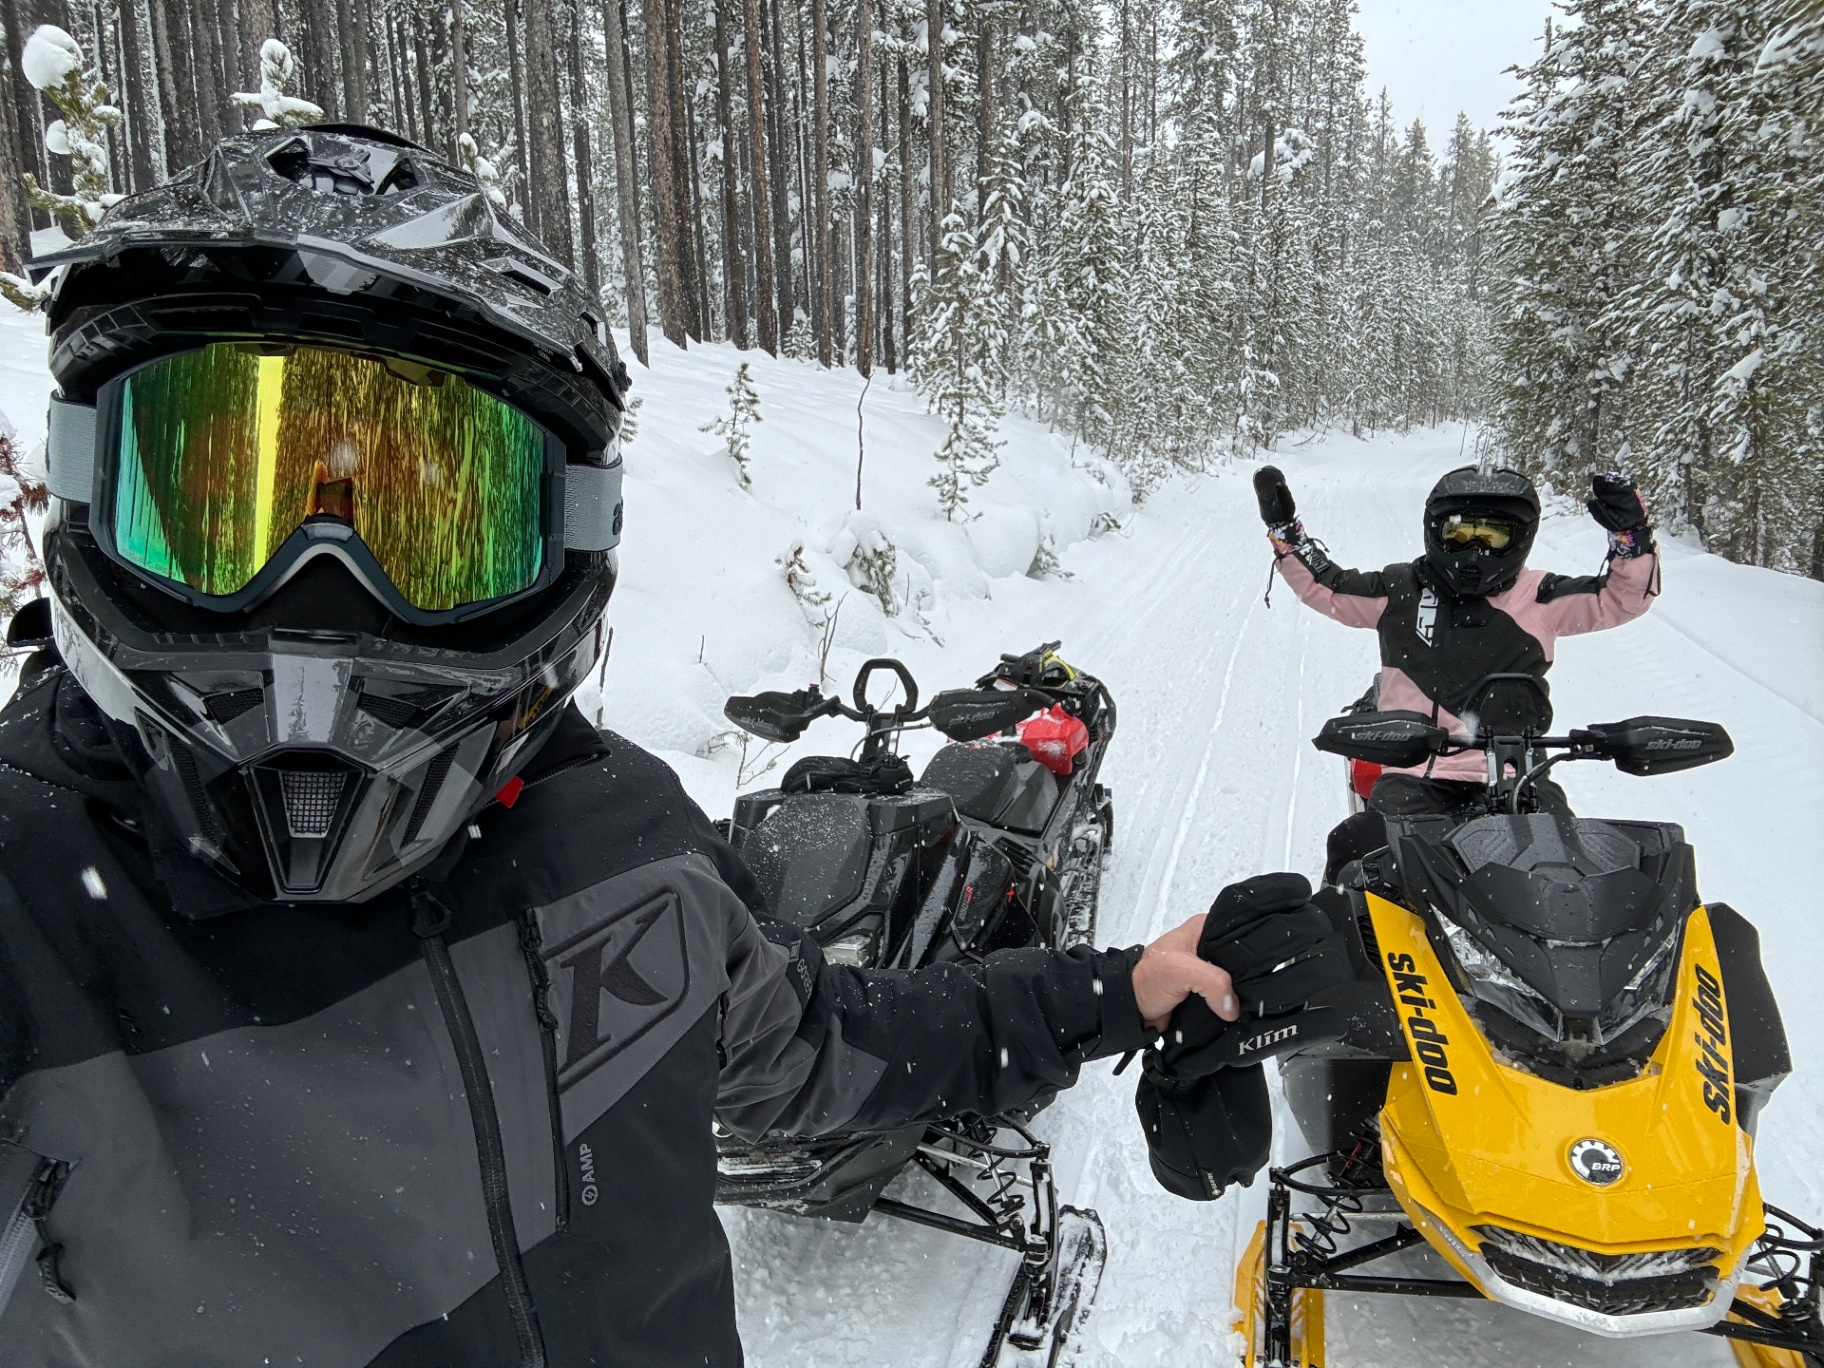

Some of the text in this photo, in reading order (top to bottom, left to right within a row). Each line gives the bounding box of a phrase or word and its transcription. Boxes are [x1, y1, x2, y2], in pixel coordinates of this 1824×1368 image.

[1355, 730, 1414, 742] ski-doo
[1645, 738, 1703, 751] ski-doo
[1387, 951, 1458, 1096] ski-doo
[1692, 963, 1732, 1126] ski-doo
[579, 1143, 596, 1183] AMP
[1591, 1162, 1621, 1172] BRP
